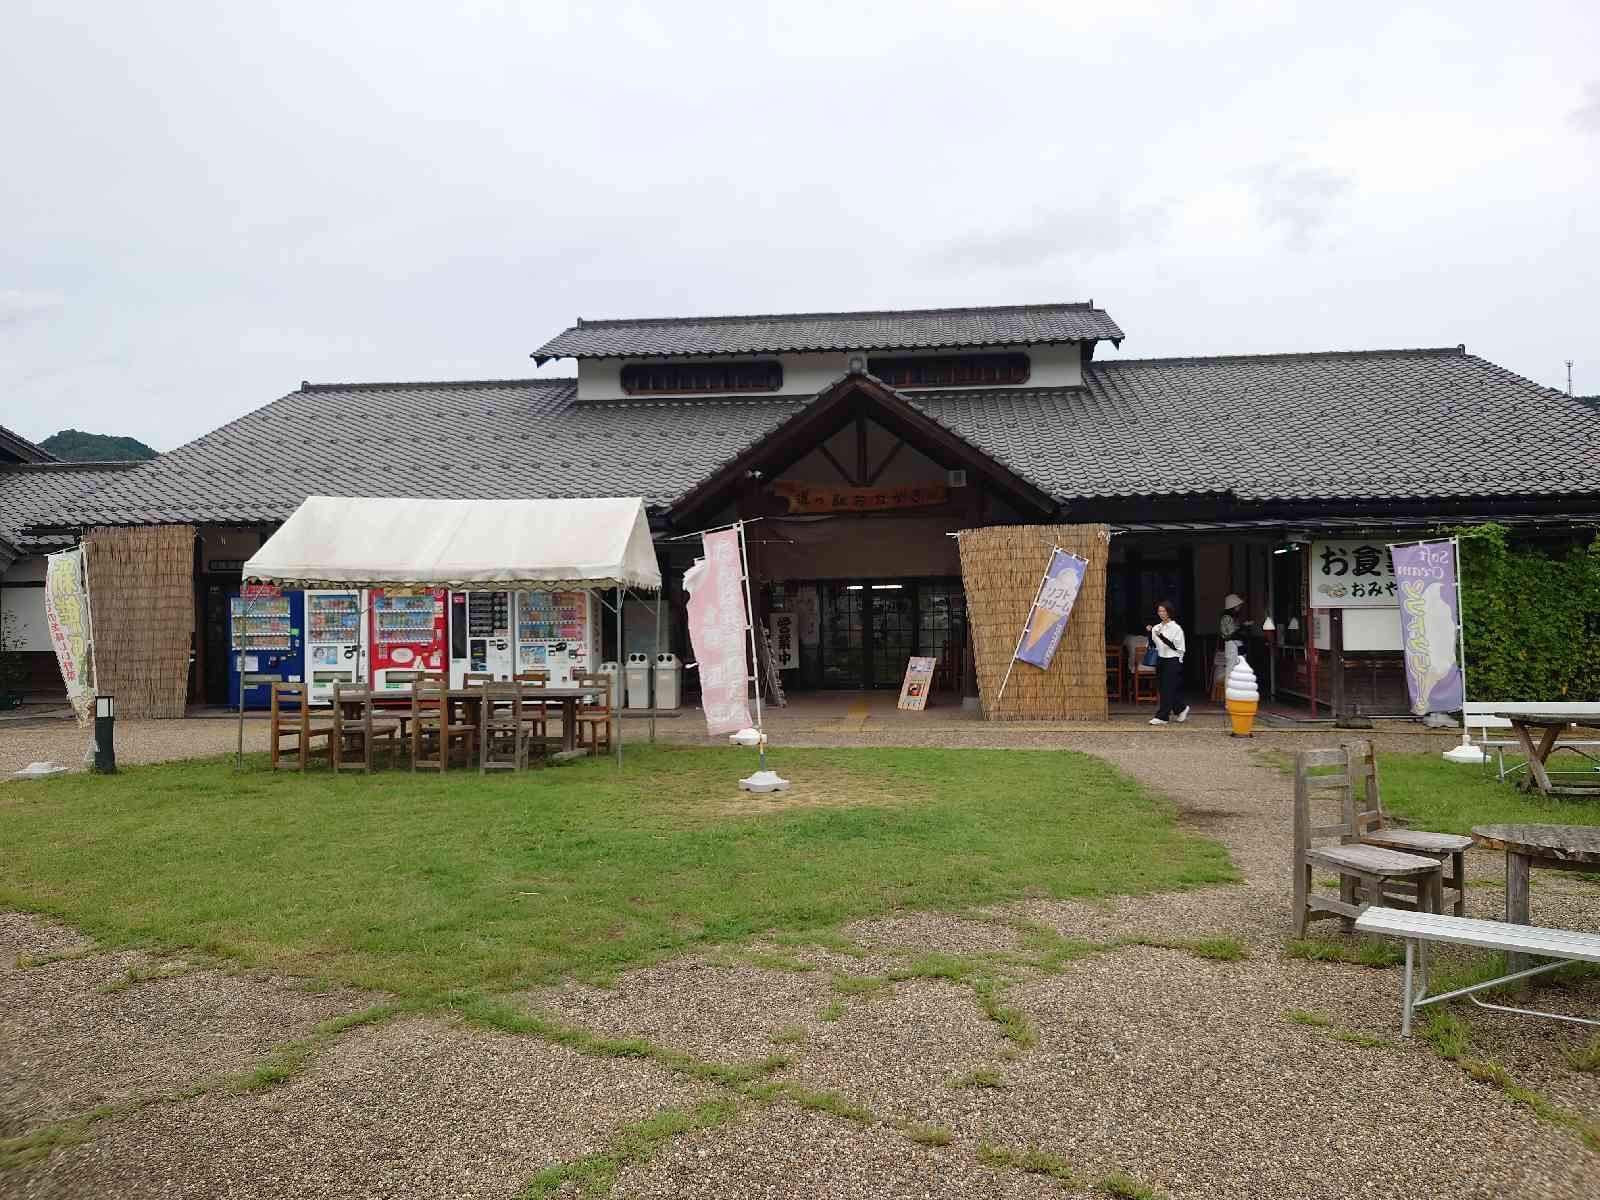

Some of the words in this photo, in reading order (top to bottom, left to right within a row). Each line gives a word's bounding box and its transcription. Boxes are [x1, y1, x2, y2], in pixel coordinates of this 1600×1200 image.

[1049, 587, 1072, 600] ソフト
[1041, 598, 1072, 612] クリーム
[776, 615, 792, 666] 営業中
